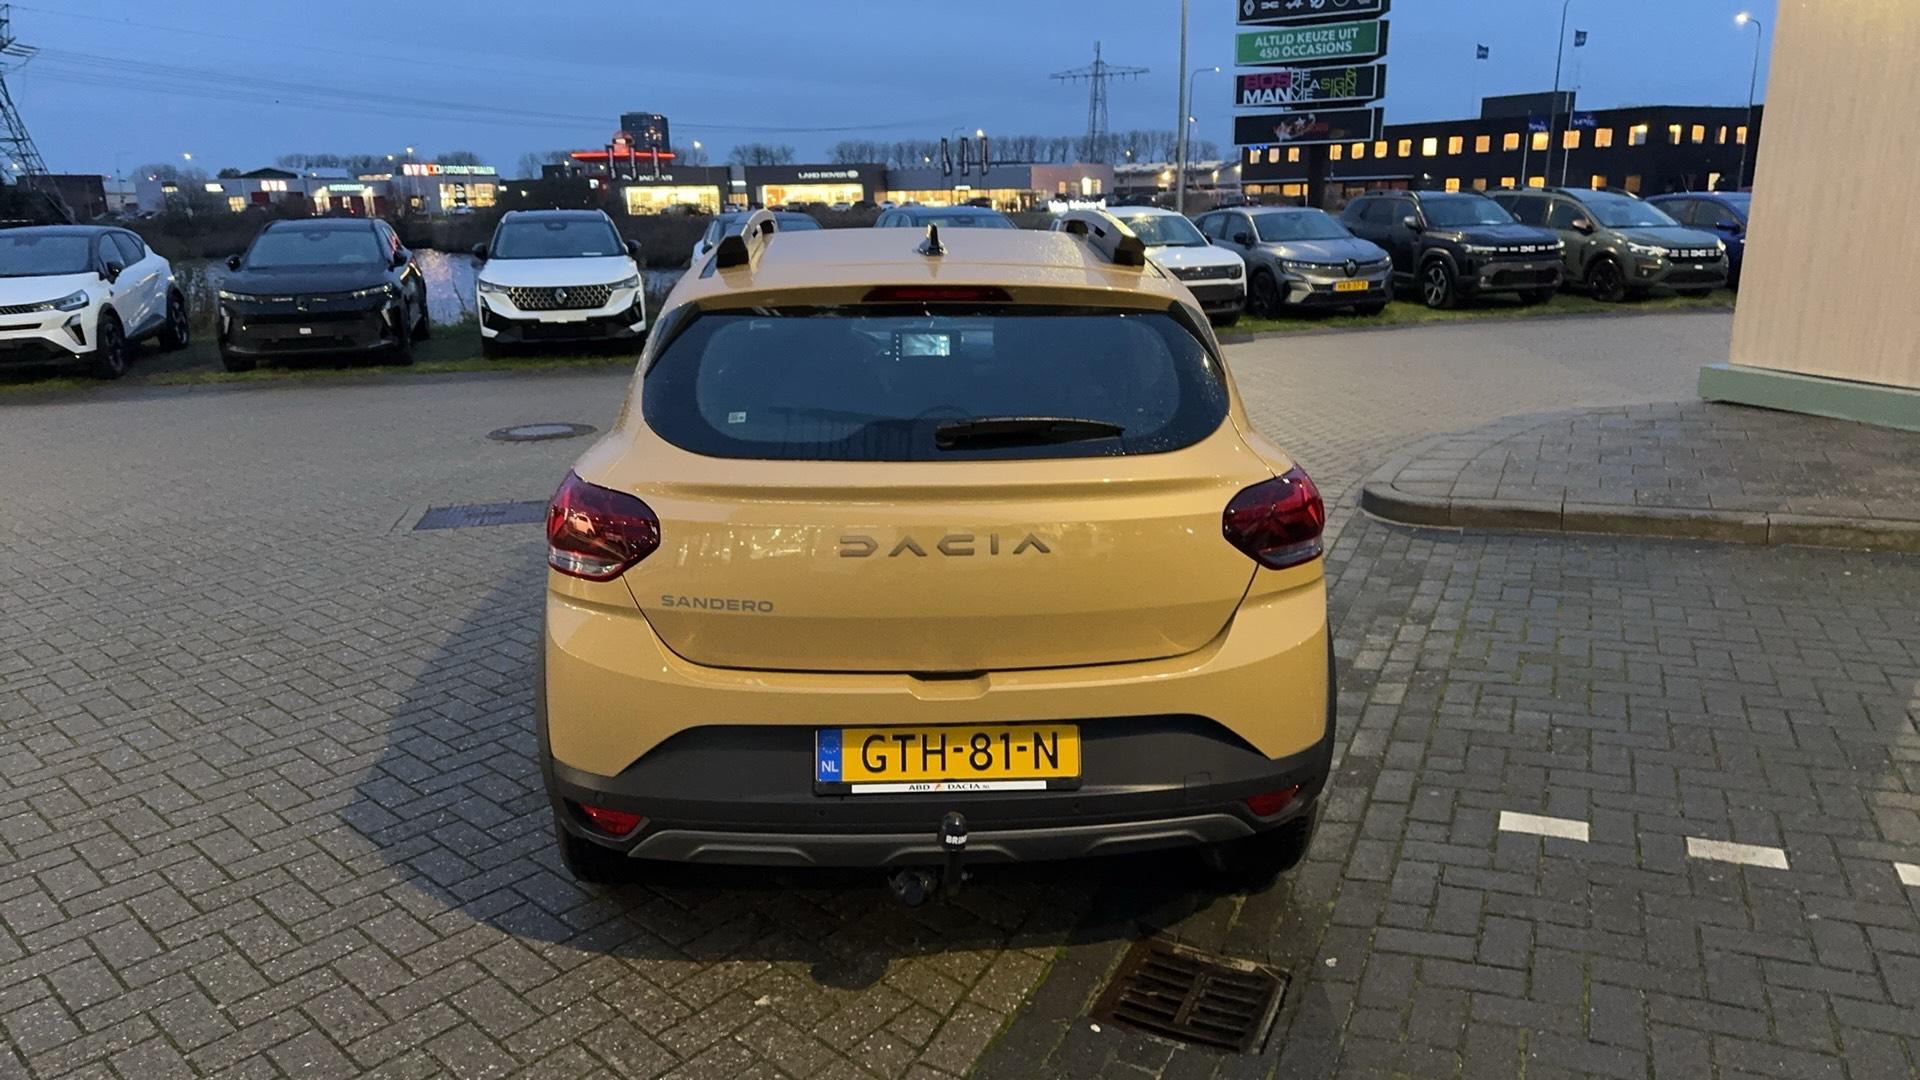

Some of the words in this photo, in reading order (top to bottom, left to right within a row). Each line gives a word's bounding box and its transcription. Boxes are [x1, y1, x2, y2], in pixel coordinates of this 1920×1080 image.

[1255, 34, 1295, 47] ALTIJD
[1297, 30, 1336, 44] KEUZE
[1338, 27, 1359, 40] UIT
[1259, 47, 1280, 59] 450
[1282, 41, 1353, 57] OCCASIONS
[1244, 72, 1291, 90] BOS
[1243, 88, 1291, 105] MAN
[798, 171, 820, 179] LAND
[820, 171, 847, 179] ROVER
[839, 533, 1051, 558] DACIA
[661, 594, 774, 613] SANDERO
[821, 761, 839, 773] NL
[861, 731, 1059, 773] GTH-81-N
